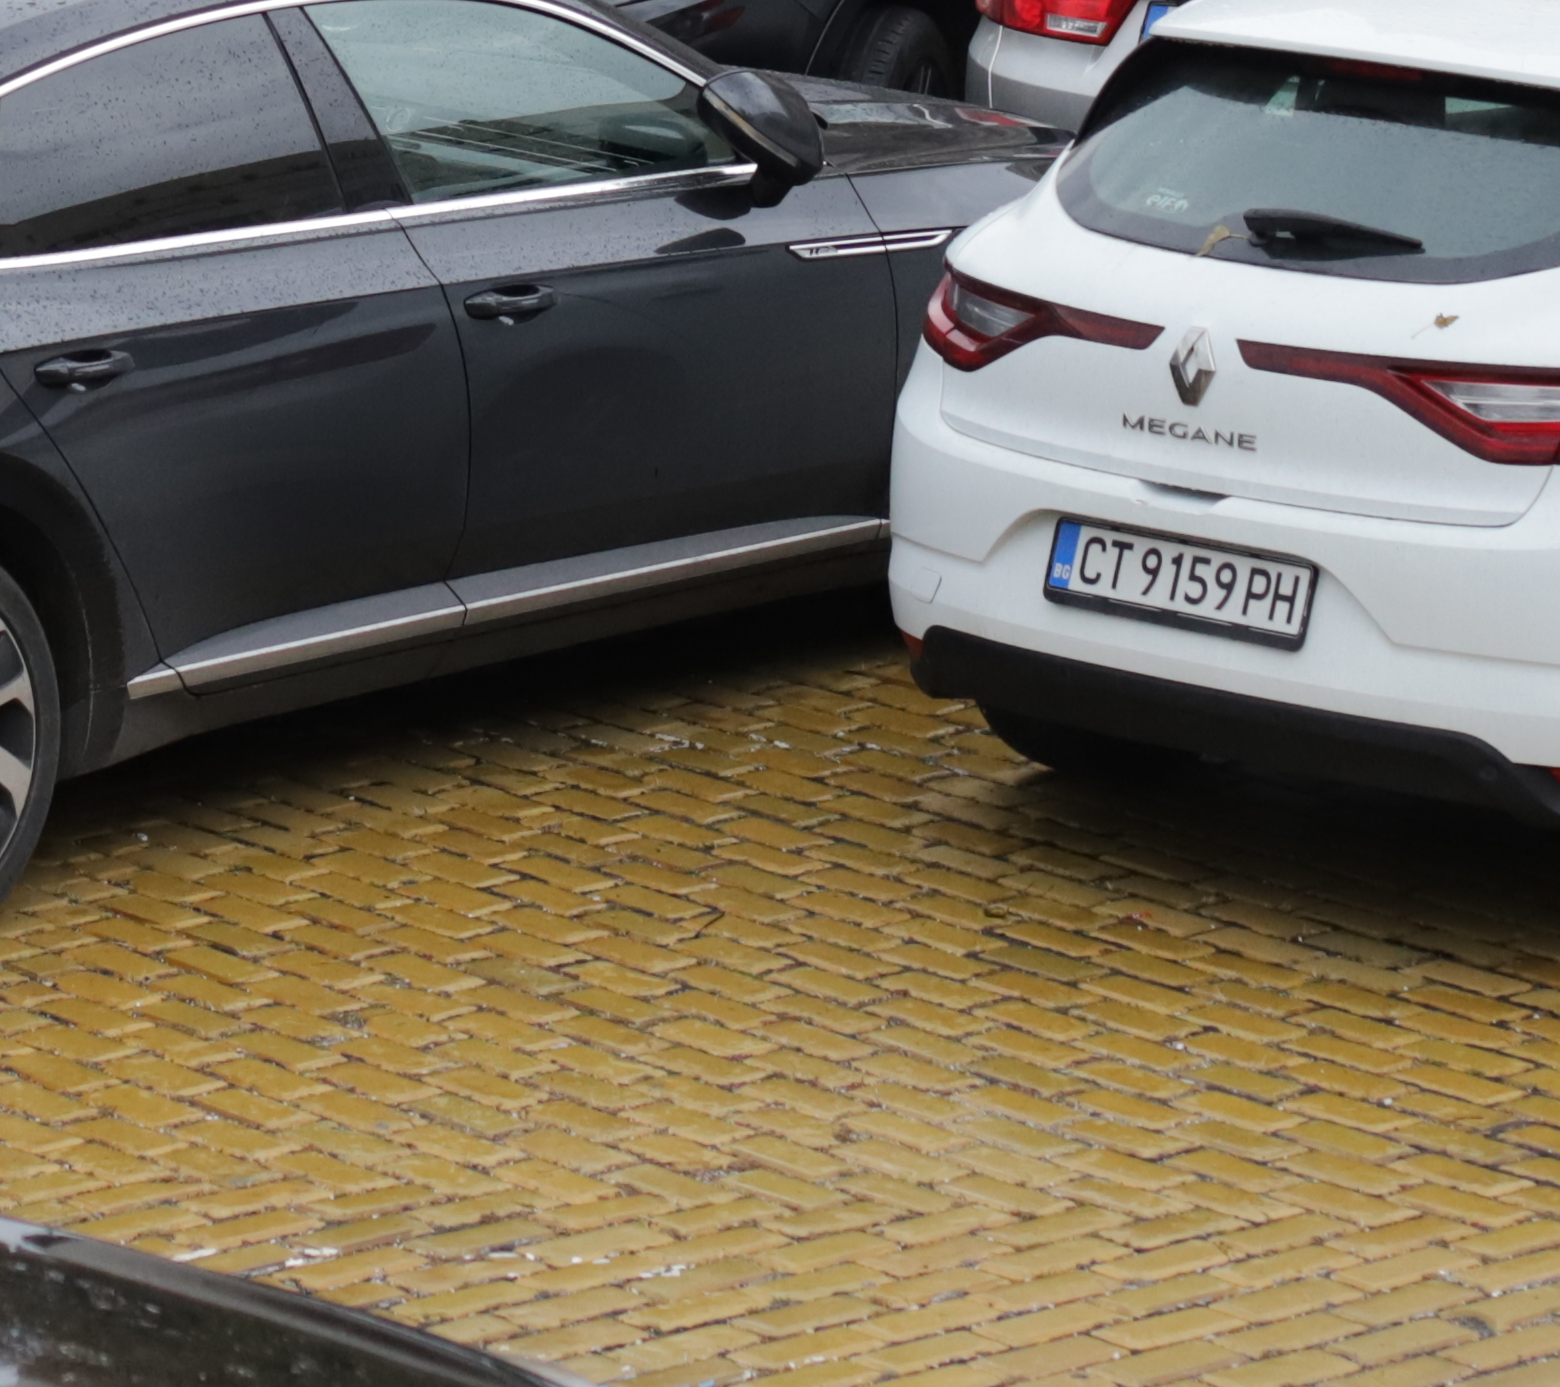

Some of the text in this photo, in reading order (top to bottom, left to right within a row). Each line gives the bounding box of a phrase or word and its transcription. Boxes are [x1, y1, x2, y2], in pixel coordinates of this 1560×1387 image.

[1122, 412, 1258, 452] MEGANE
[1053, 536, 1301, 625] BG CT 9159 PH
